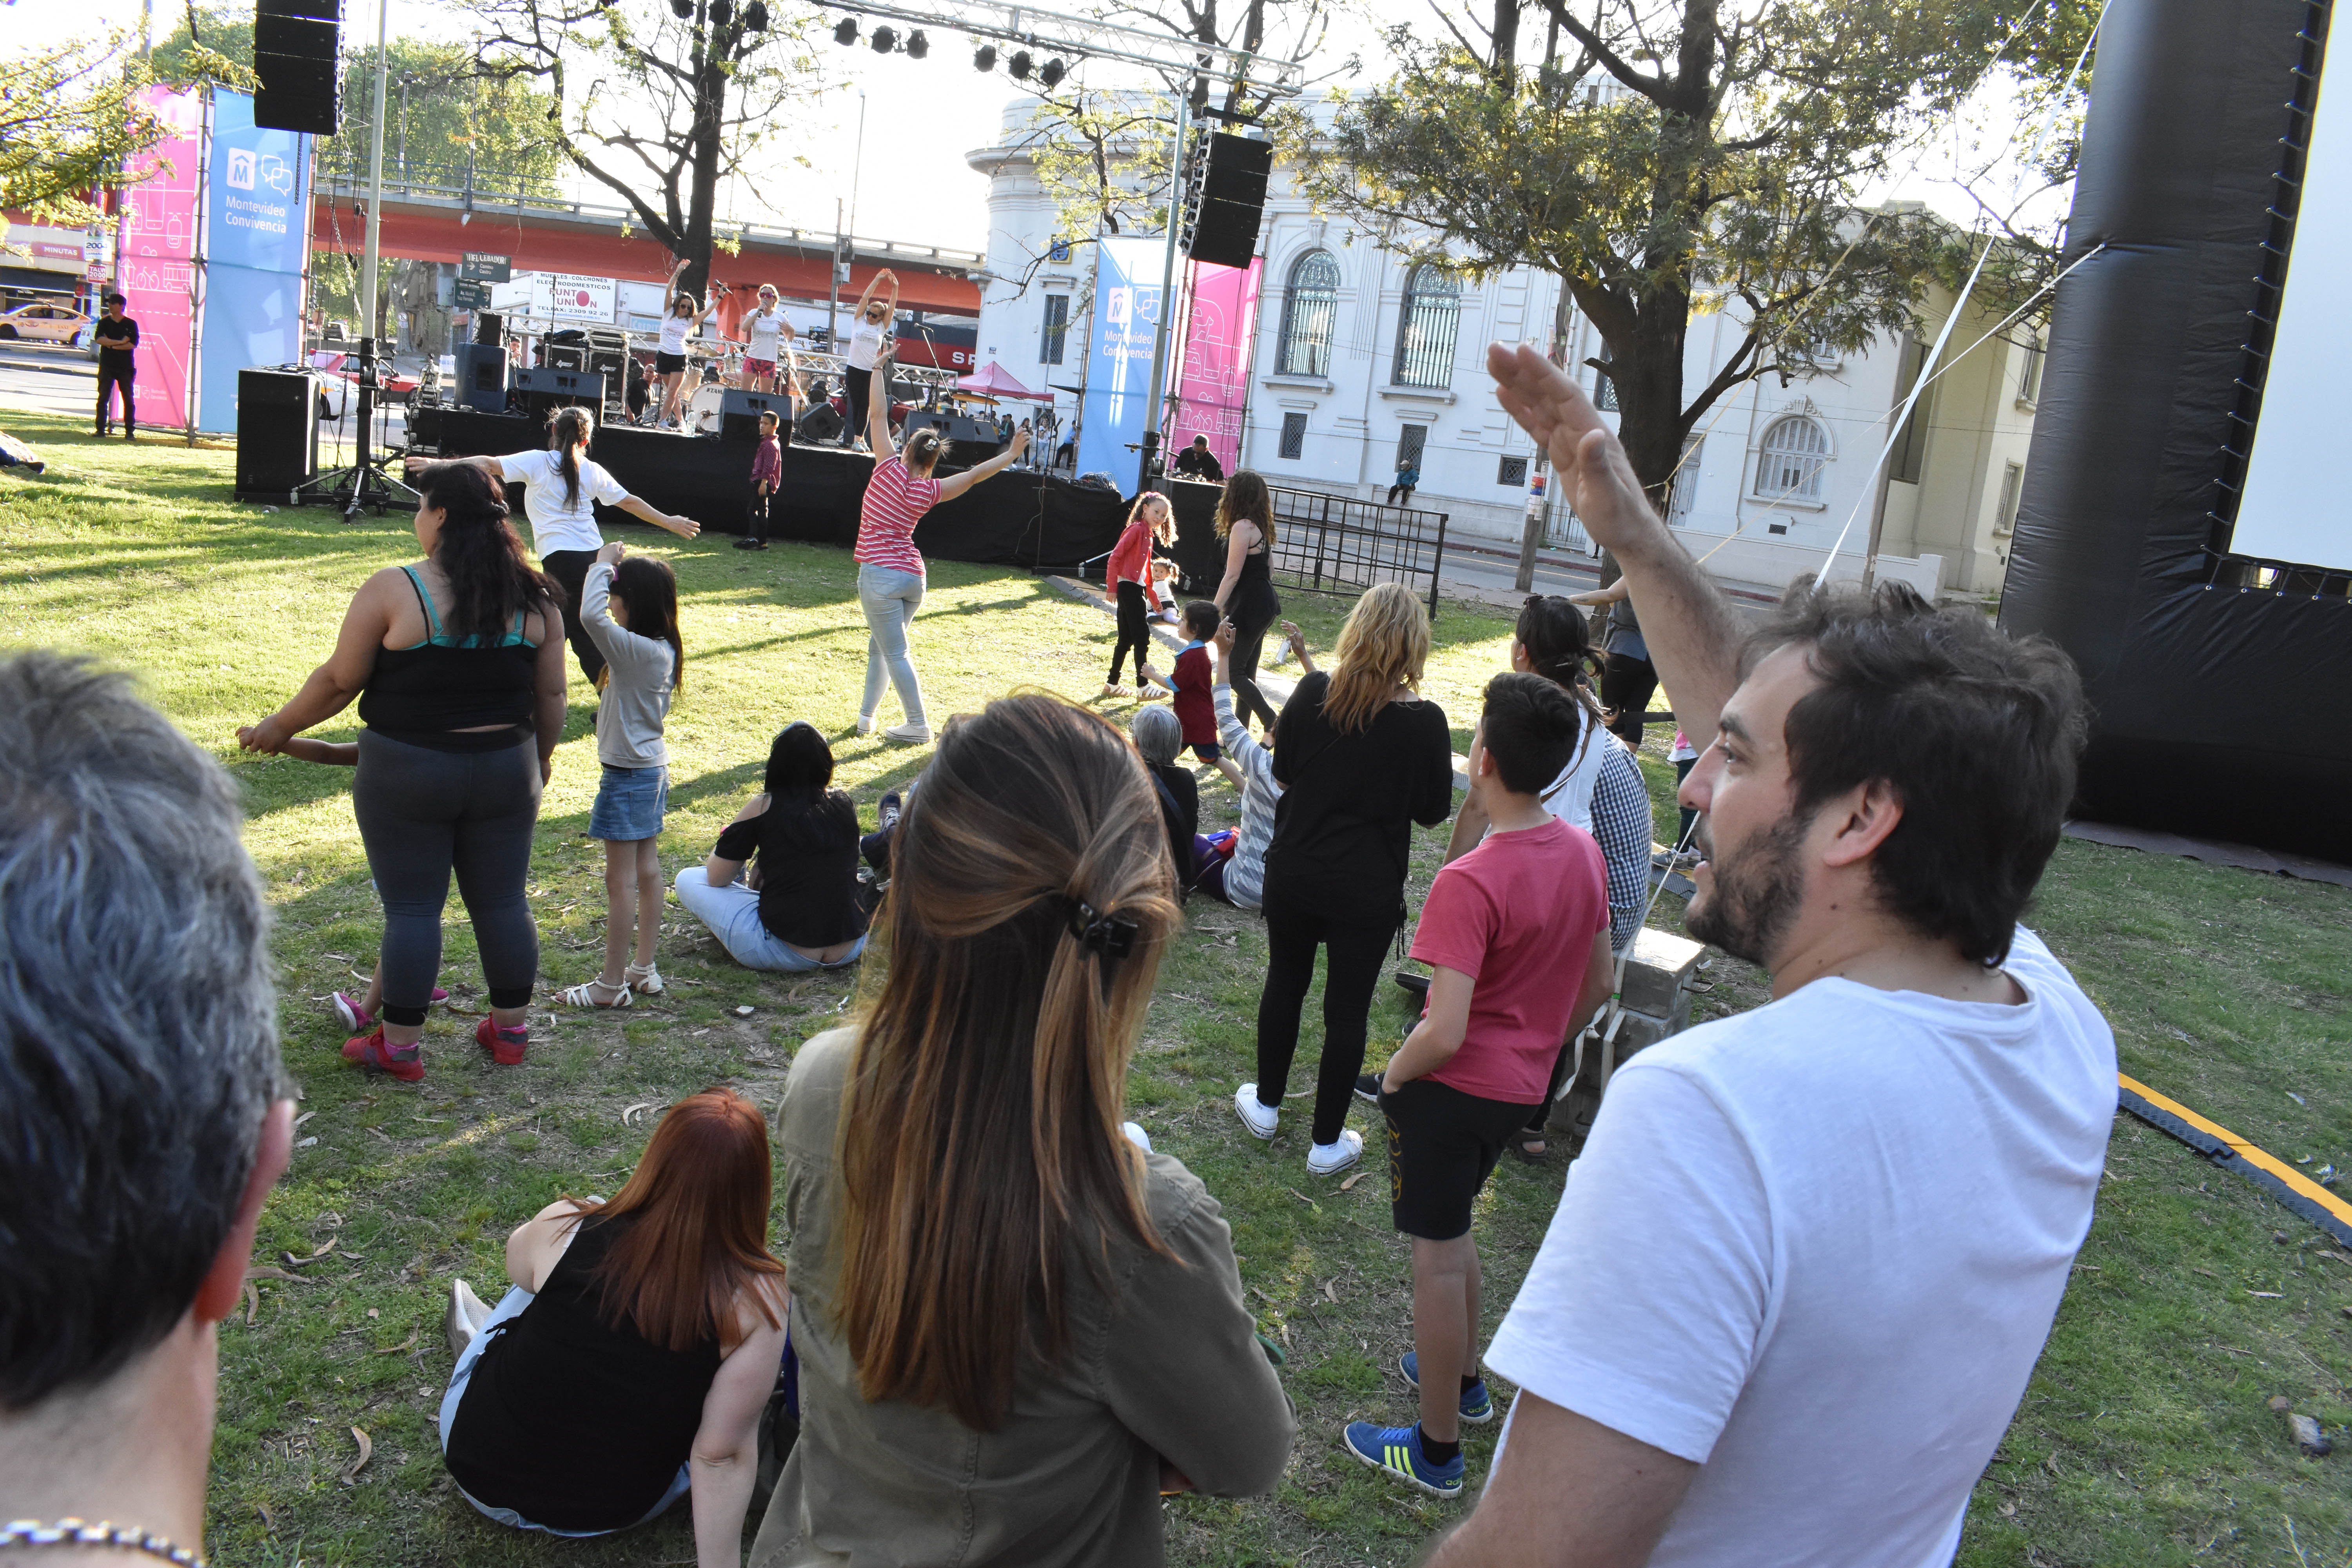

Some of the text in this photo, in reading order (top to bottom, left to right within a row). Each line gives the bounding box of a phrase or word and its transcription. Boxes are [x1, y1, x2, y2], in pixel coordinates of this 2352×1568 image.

[226, 195, 285, 217] Montevideo
[225, 212, 287, 233] Convivencia
[44, 246, 78, 256] MINUTAS
